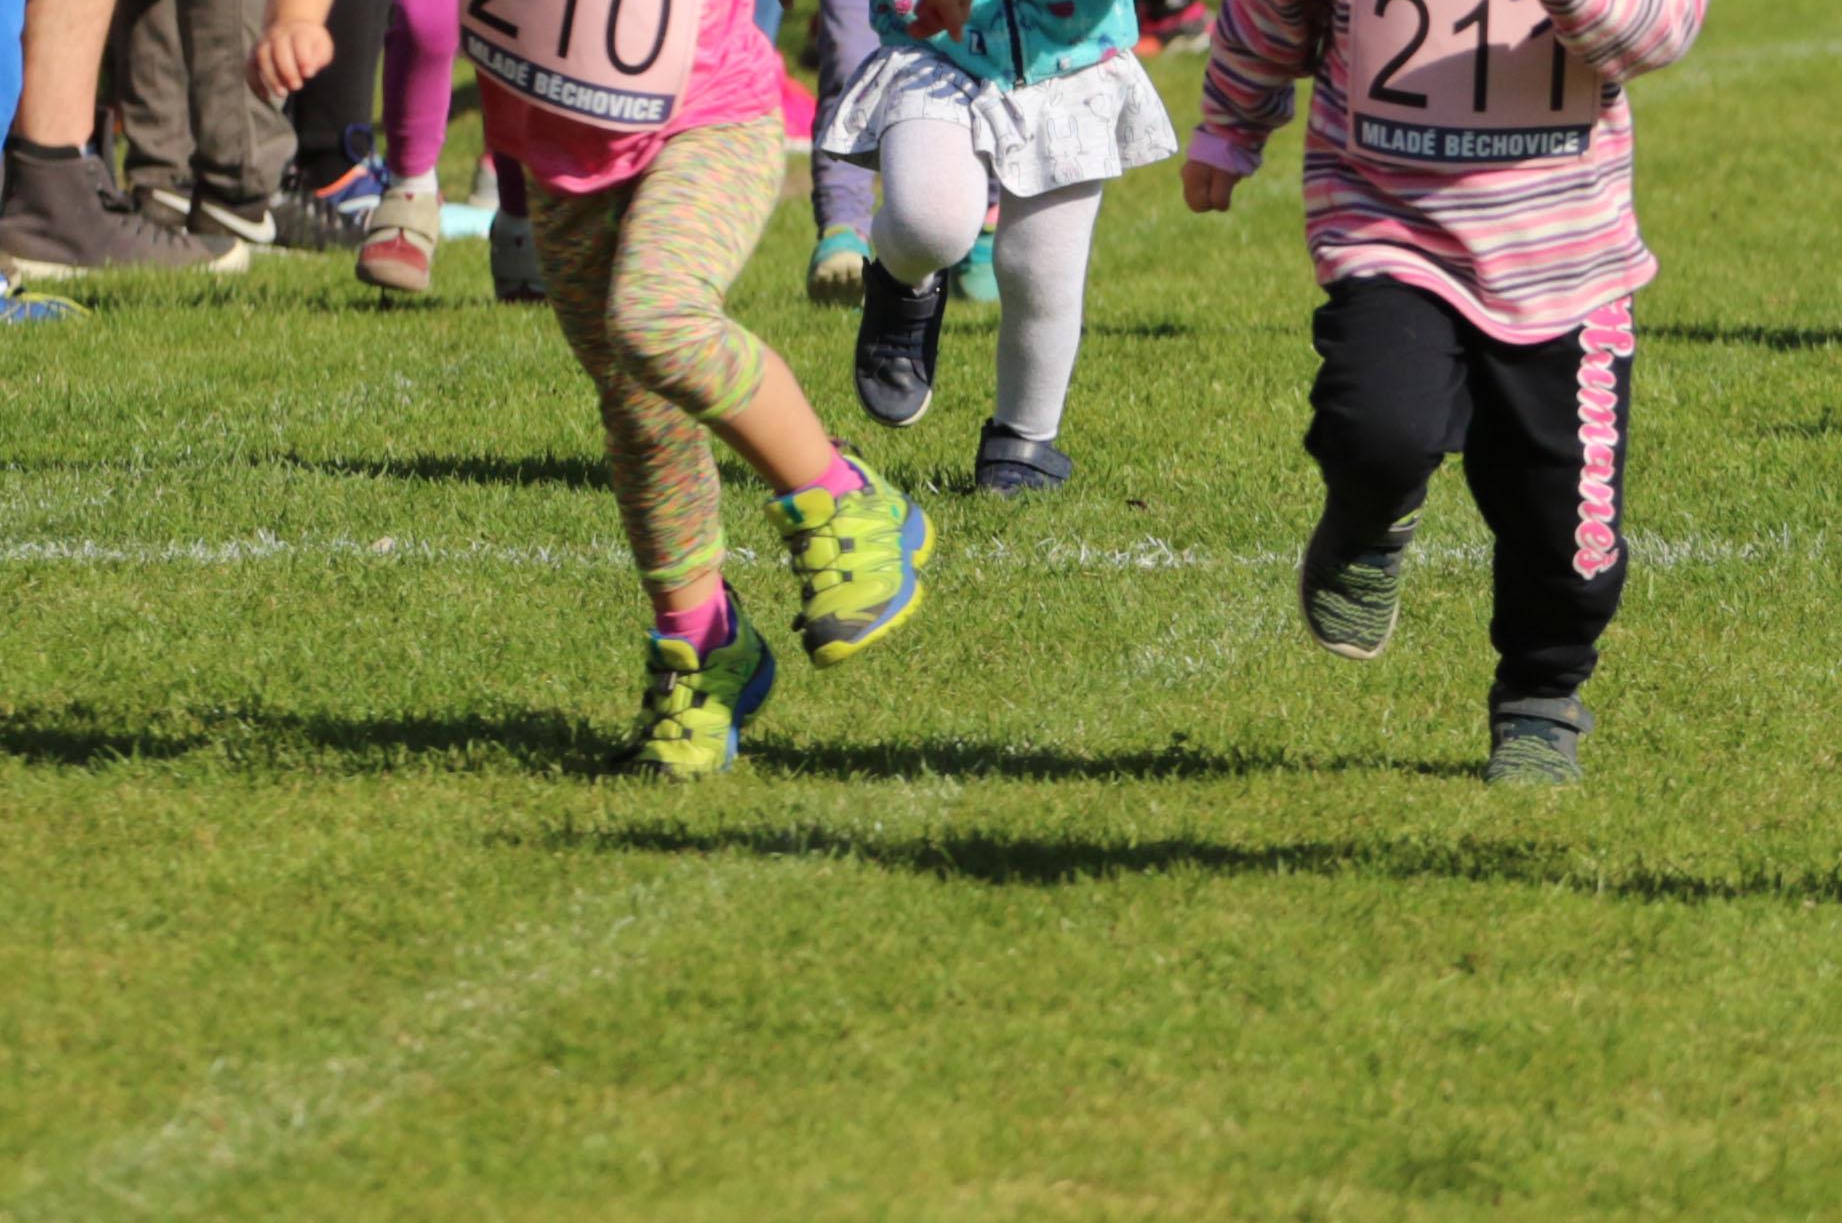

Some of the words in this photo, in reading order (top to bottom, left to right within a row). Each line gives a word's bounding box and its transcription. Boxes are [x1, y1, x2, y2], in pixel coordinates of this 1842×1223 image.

[467, 35, 532, 86] MLADÉ
[1361, 120, 1437, 156] MLADÉ
[1444, 128, 1579, 158] BĚCHOVICE
